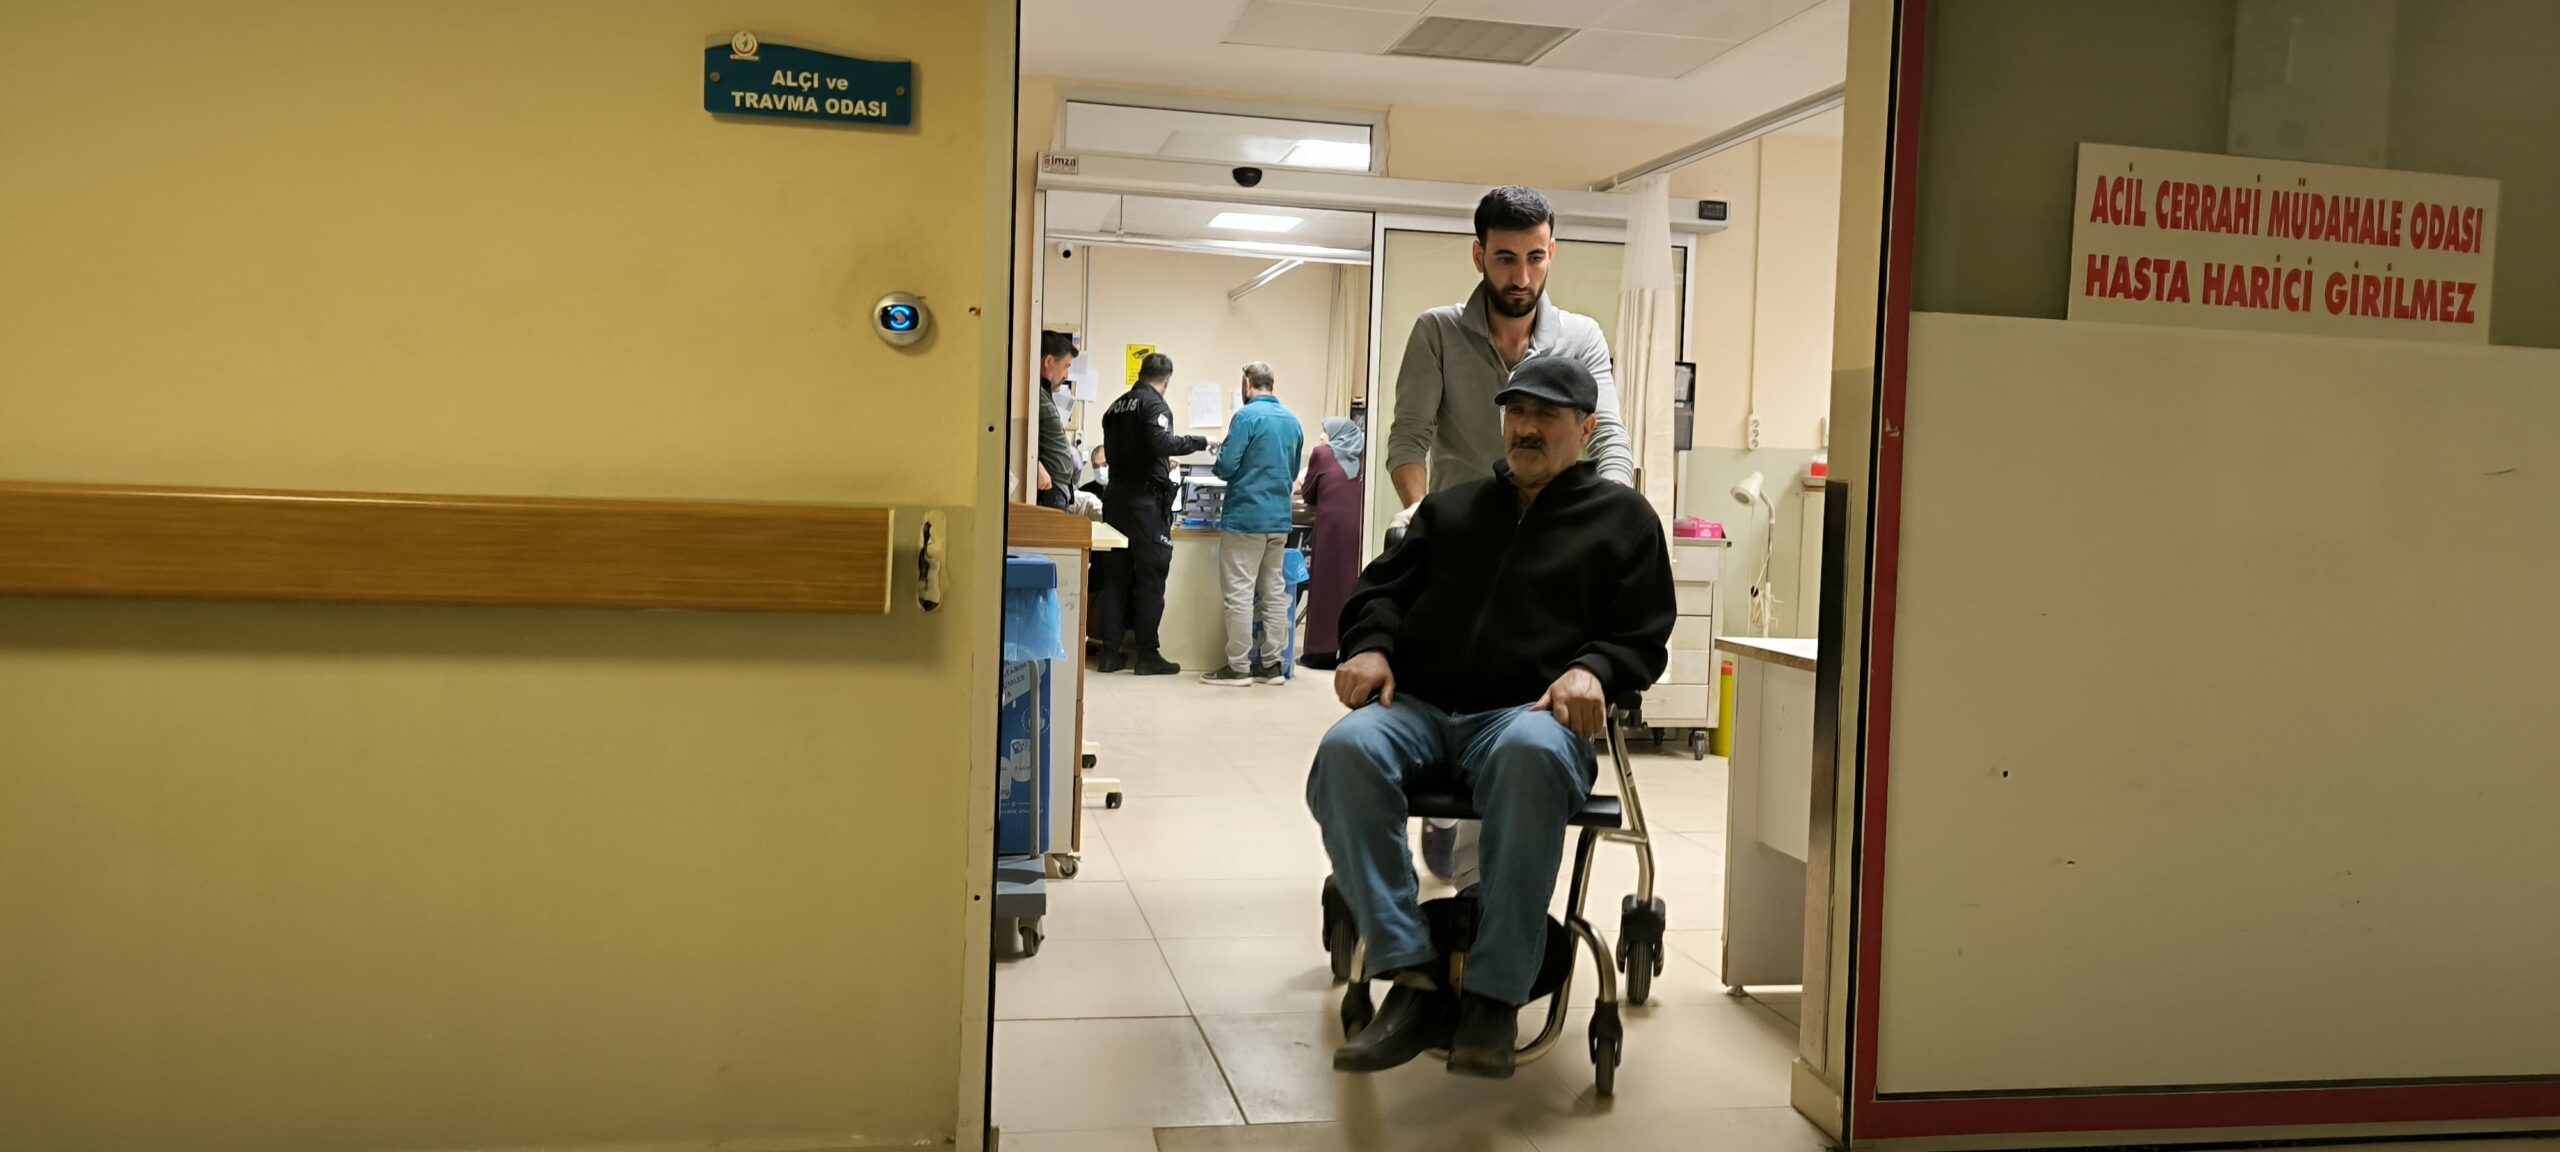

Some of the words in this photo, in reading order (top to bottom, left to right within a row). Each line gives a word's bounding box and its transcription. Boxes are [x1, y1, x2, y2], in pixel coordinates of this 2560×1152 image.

[731, 91, 818, 113] TRAVMA
[825, 98, 887, 117] ODASI
[771, 70, 819, 92] ALÇI
[826, 77, 849, 90] ve
[2090, 163, 2146, 227] ACİL
[2156, 174, 2262, 236] CERRAHİ
[2267, 177, 2403, 248] MÜDAHALE
[2410, 202, 2483, 254] ODASI
[2085, 254, 2191, 304] HASTA
[2202, 254, 2313, 312] HARİCİ
[2324, 260, 2477, 324] GİRİLMEZ
